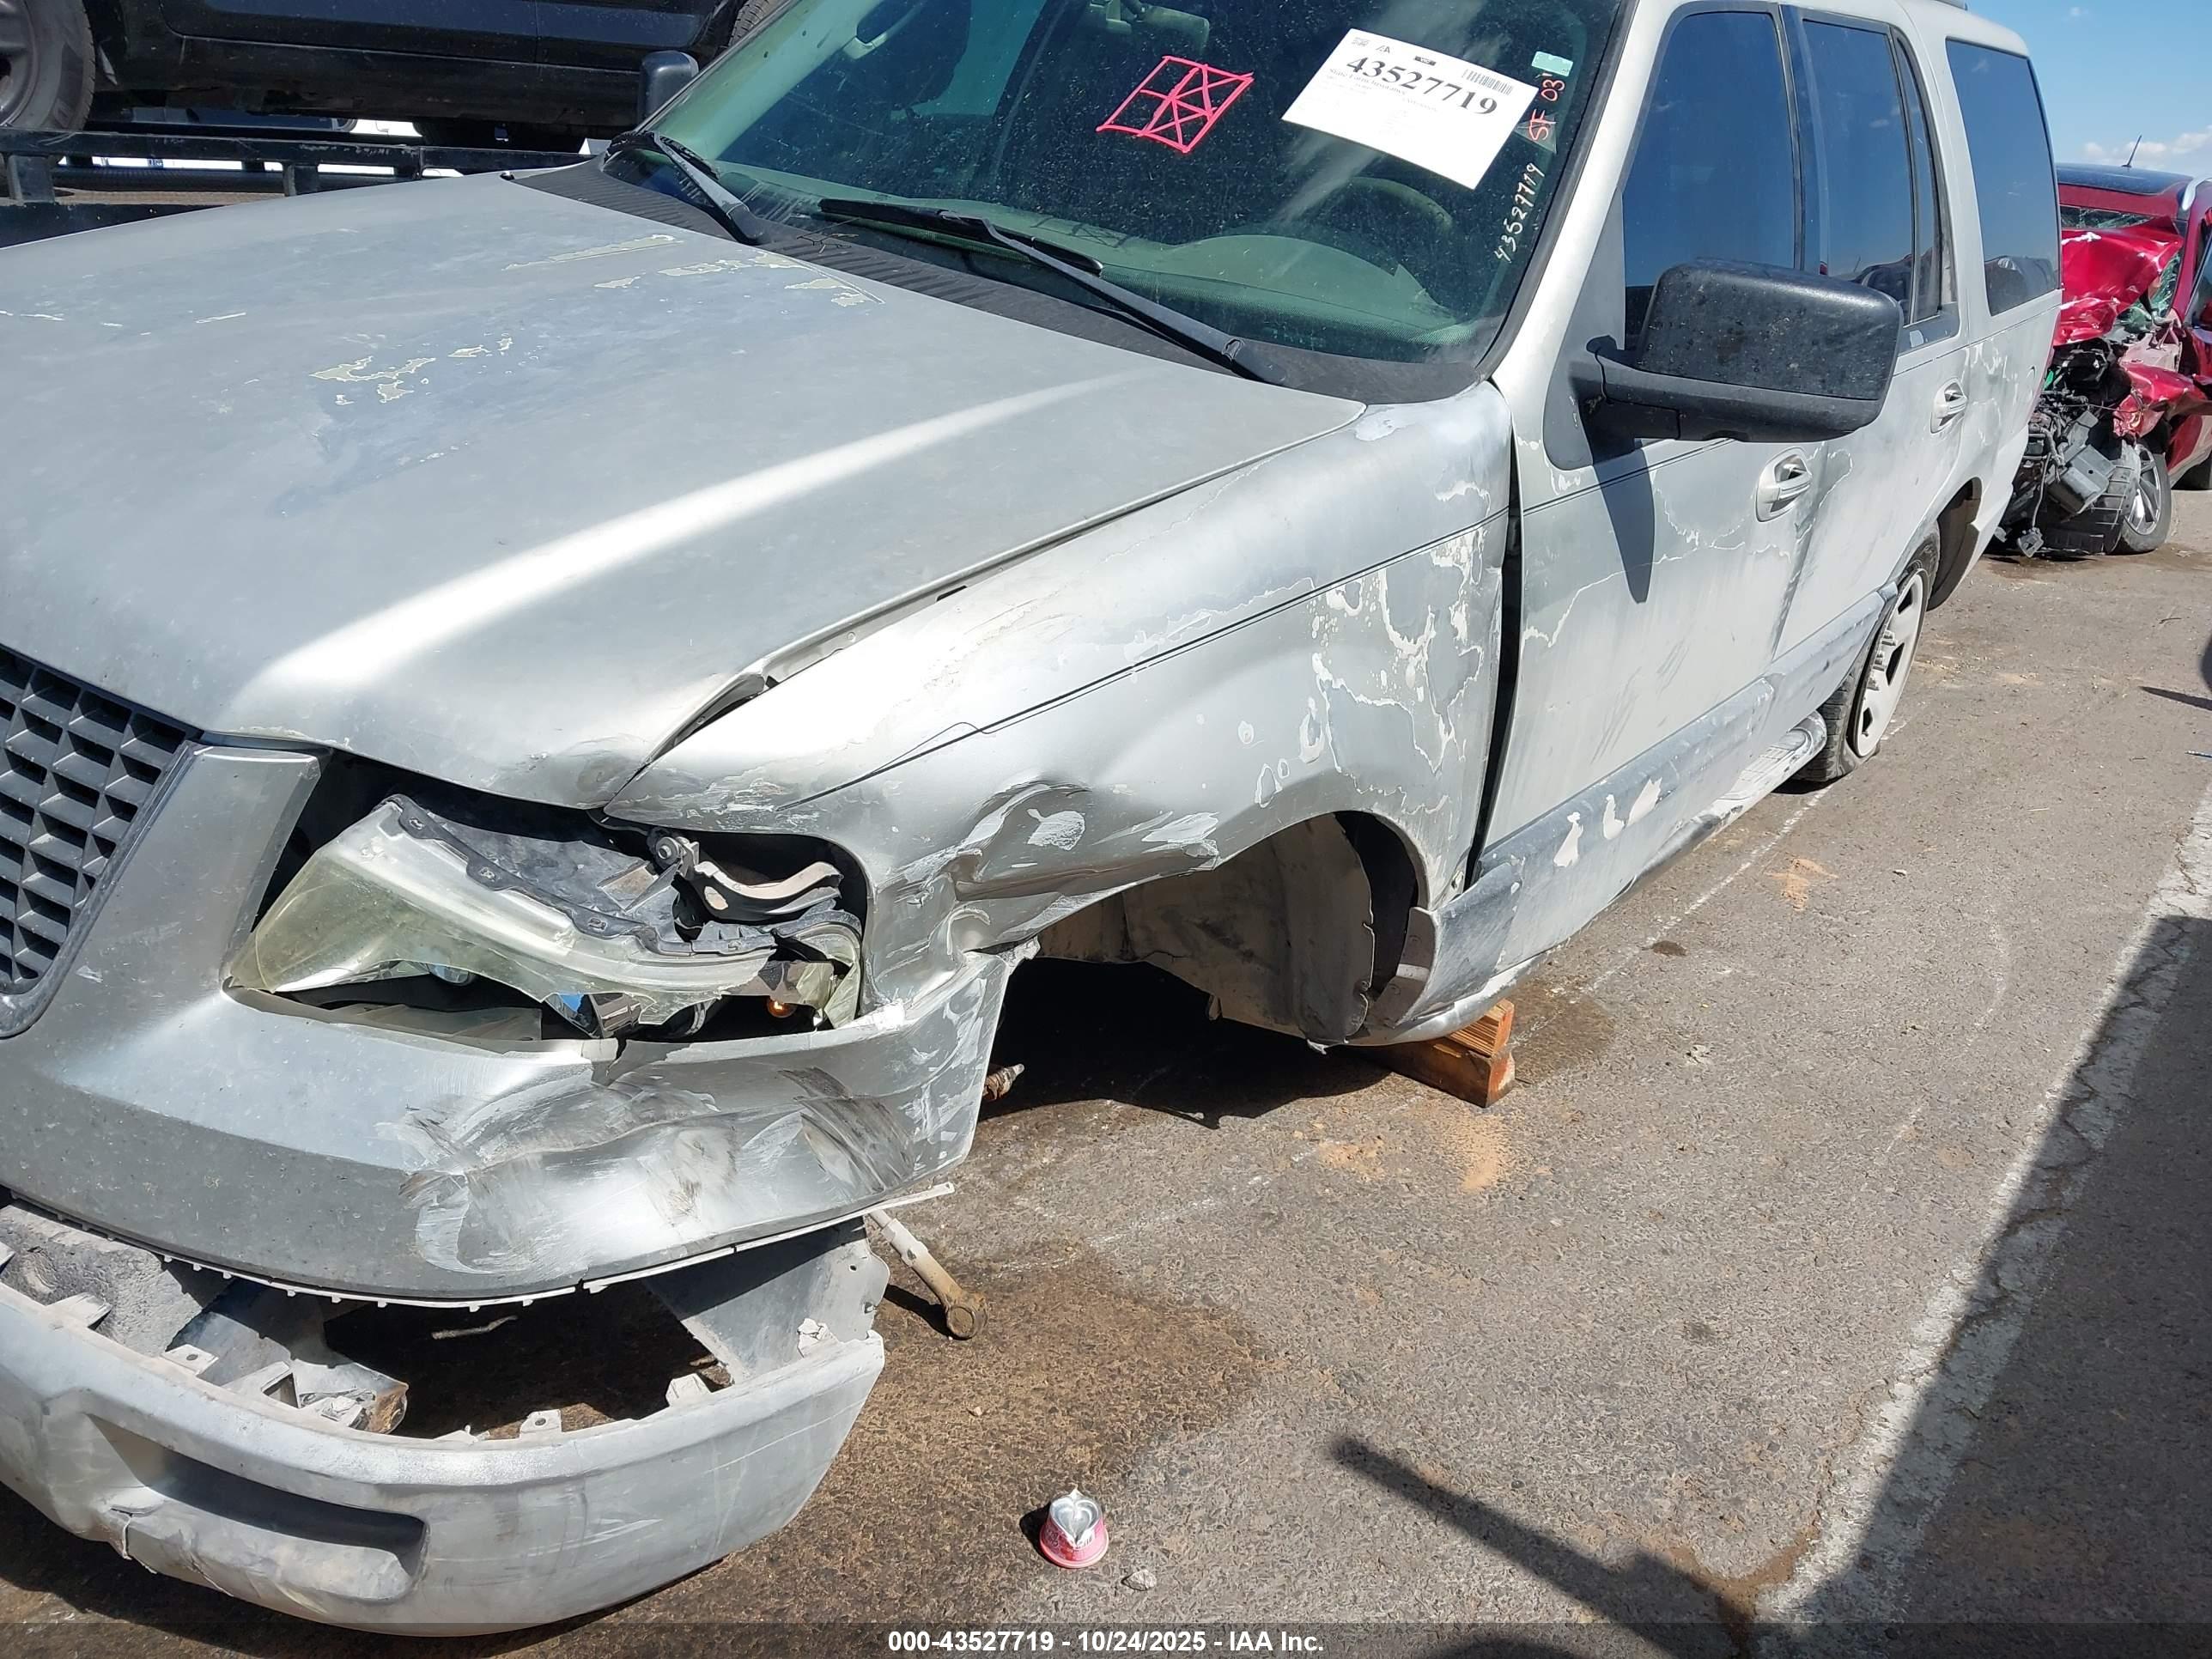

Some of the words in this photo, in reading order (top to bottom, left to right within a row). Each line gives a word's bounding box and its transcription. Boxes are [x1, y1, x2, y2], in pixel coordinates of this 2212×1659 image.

[1346, 57, 1498, 115] 43527719
[1540, 79, 1565, 101] 03
[1494, 162, 1545, 264] 43527719
